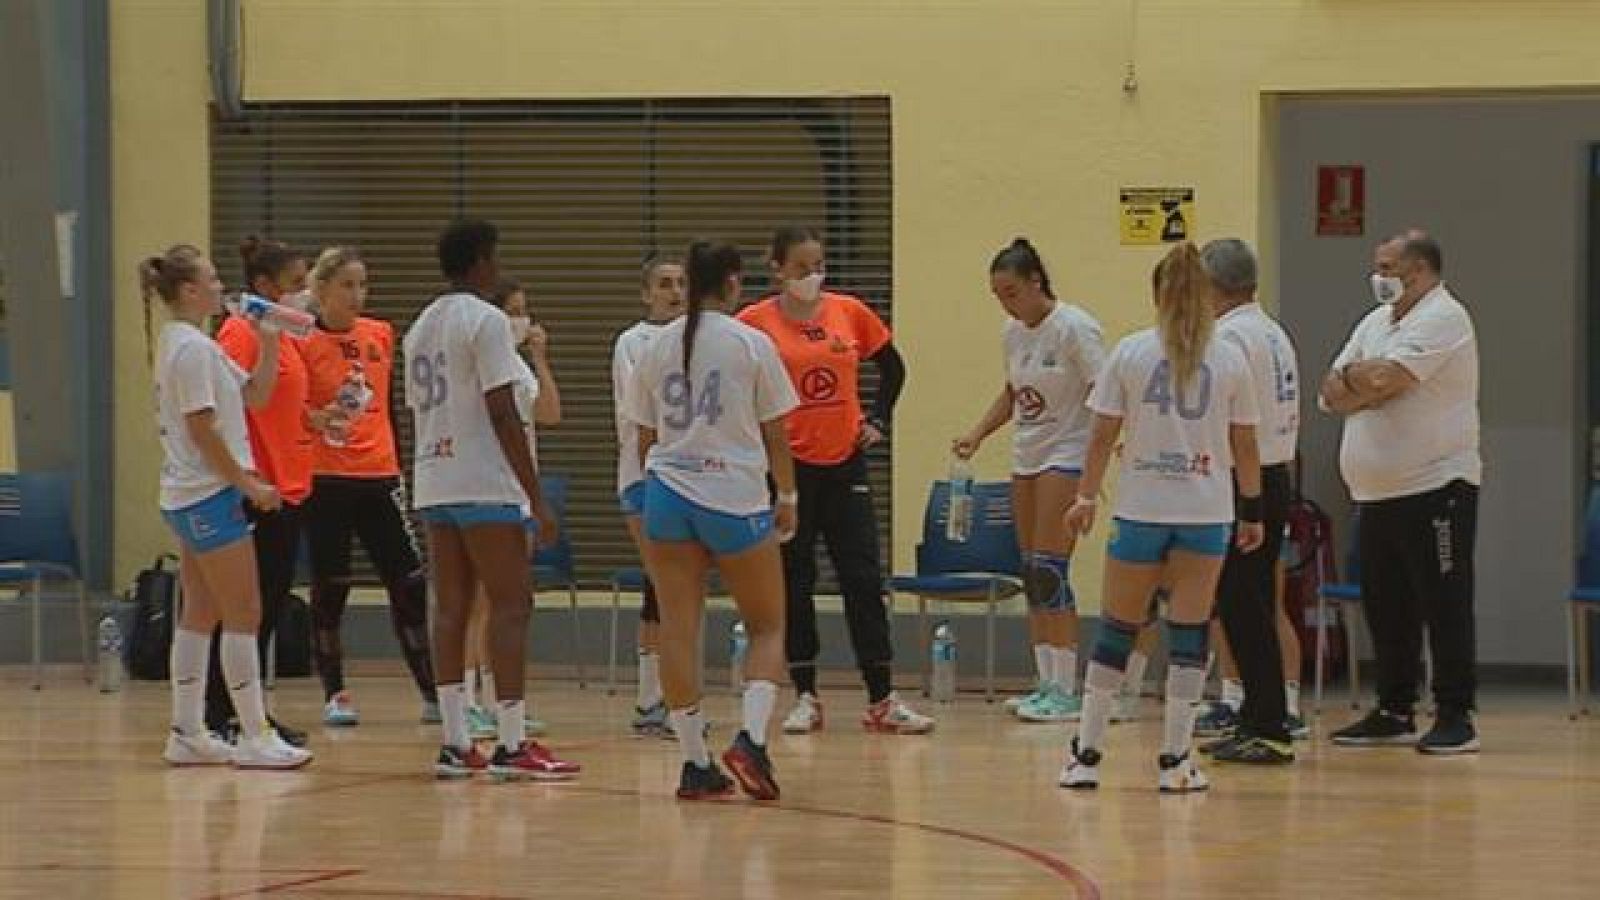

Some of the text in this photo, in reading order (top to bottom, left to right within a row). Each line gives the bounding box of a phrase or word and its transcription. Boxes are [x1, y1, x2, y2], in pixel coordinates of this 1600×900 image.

[411, 351, 447, 412] 96
[663, 369, 723, 430] 94
[1141, 360, 1211, 420] 40
